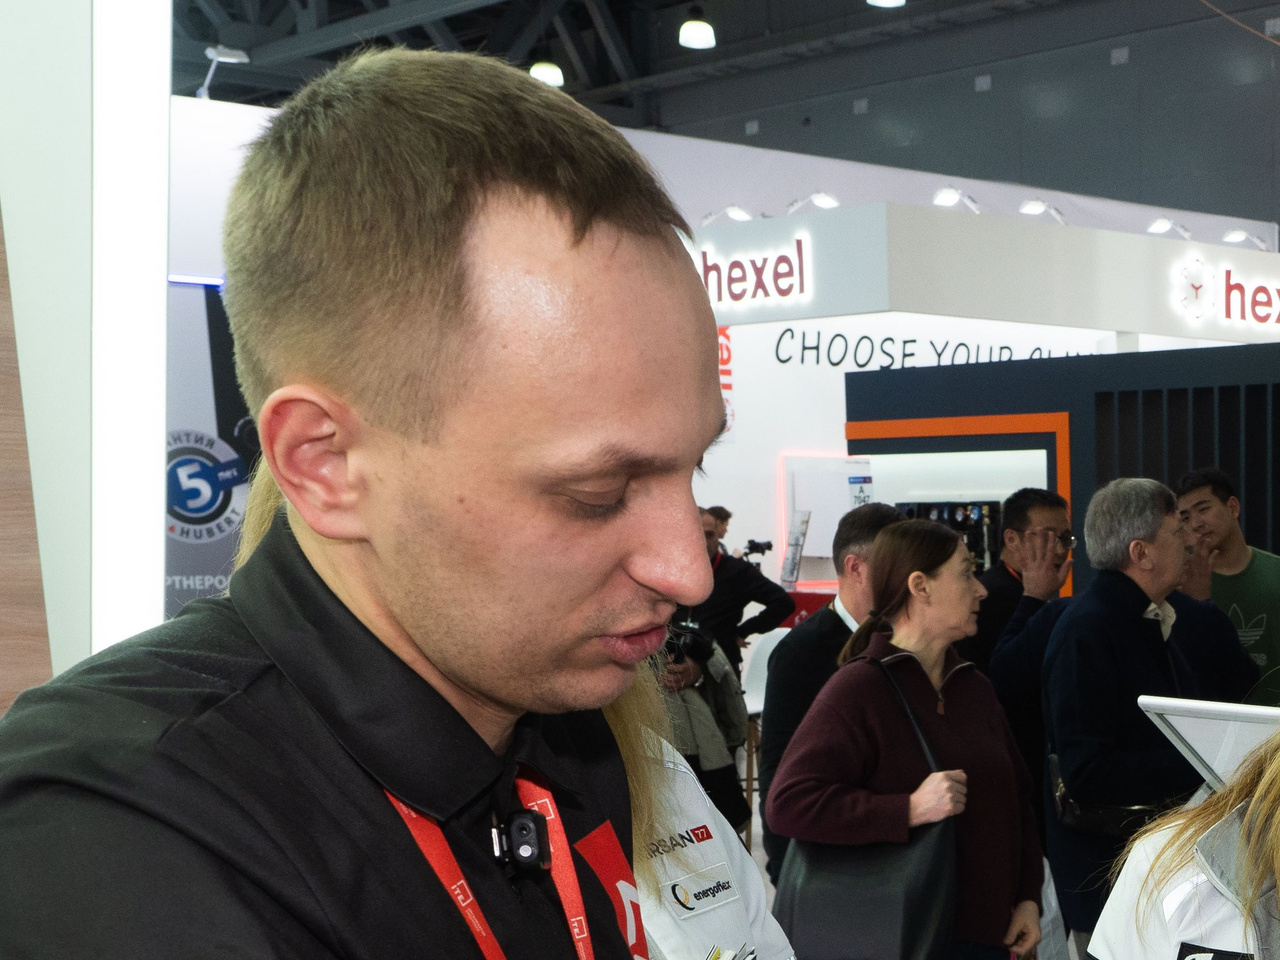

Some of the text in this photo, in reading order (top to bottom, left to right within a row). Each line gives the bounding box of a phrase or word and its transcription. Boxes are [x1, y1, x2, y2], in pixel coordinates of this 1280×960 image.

[701, 239, 804, 302] hexel
[775, 328, 917, 370] CHOOSE
[176, 462, 213, 509] 5
[694, 828, 707, 839] 77
[693, 881, 732, 901] energoflex
